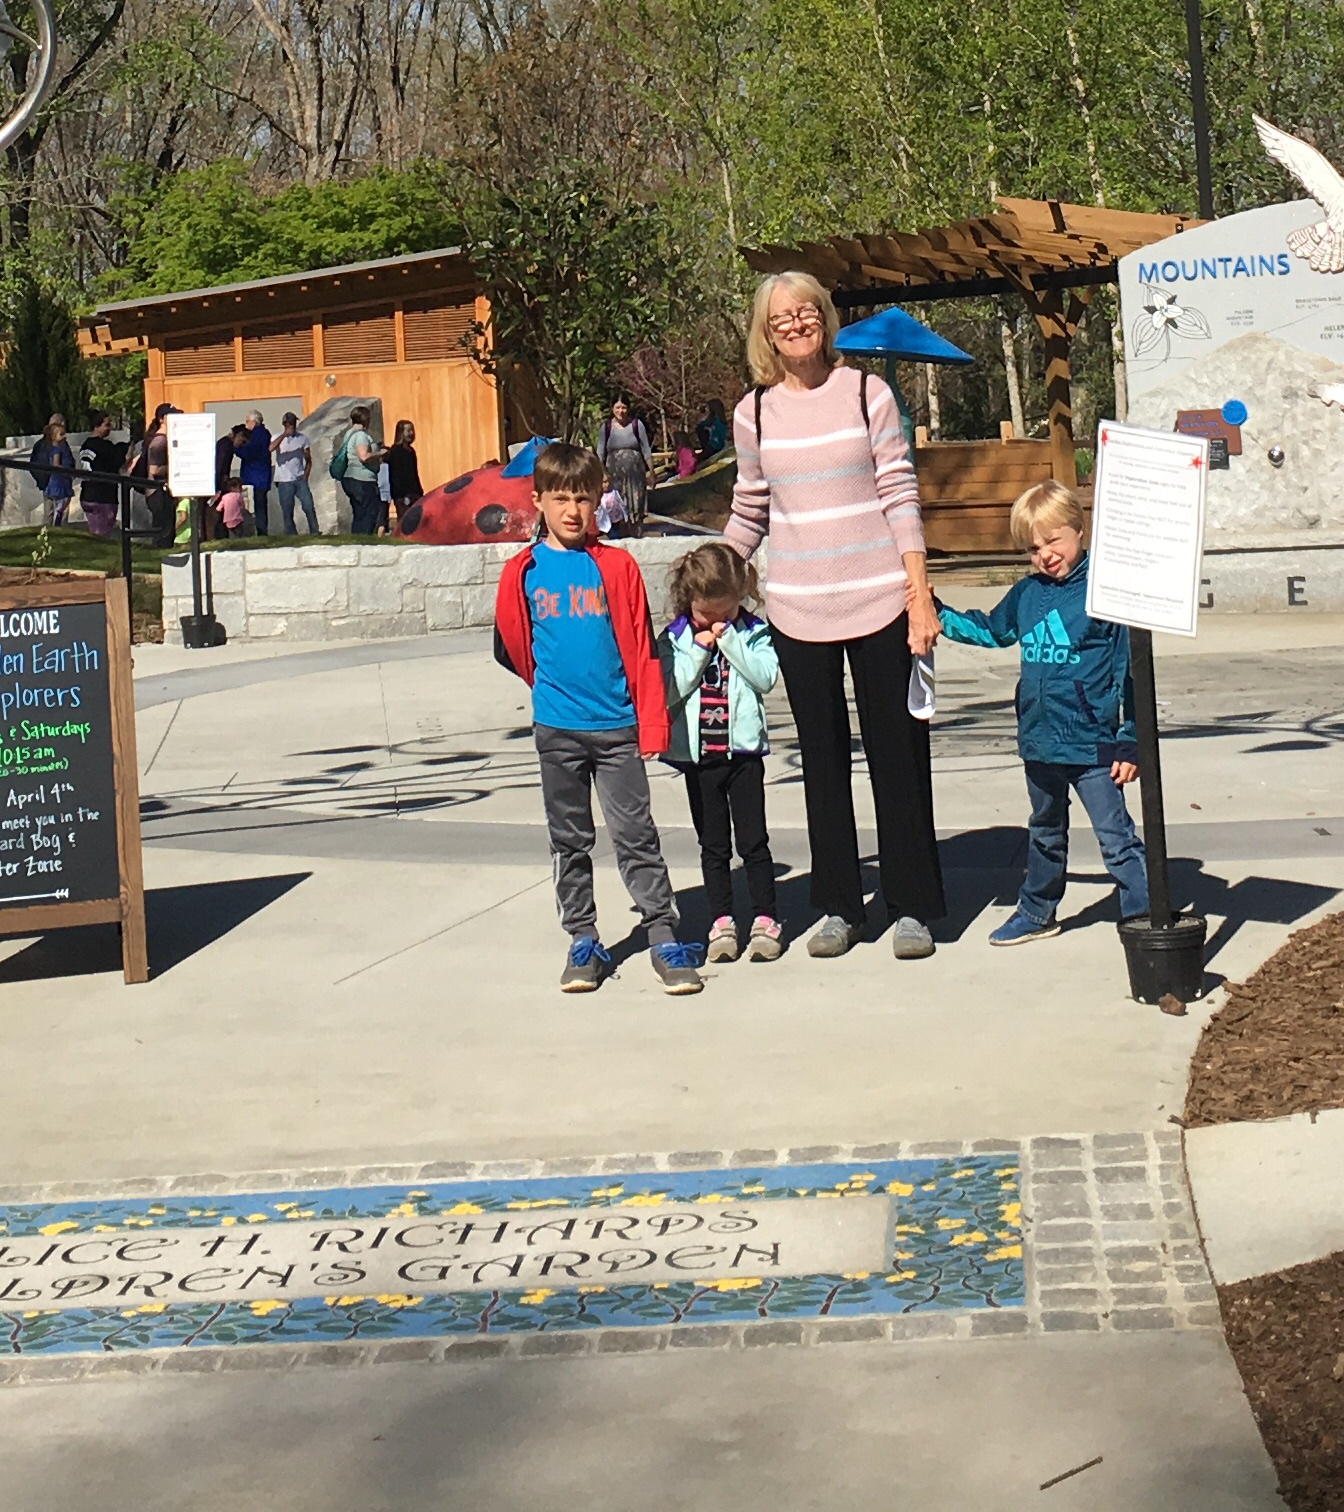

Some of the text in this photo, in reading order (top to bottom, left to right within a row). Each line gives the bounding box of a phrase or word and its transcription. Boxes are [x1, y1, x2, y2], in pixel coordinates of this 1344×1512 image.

[1138, 253, 1290, 284] MOUNTAINS
[534, 586, 561, 620] BE
[32, 641, 99, 674] Earth
[21, 719, 91, 744] Saturdays
[33, 747, 55, 759] am
[6, 784, 45, 809] April
[50, 783, 75, 804] 4th
[1, 815, 30, 830] meet
[35, 813, 55, 836] you
[60, 812, 73, 823] in
[30, 833, 61, 856] Bog
[23, 855, 63, 877] Zone
[199, 1231, 271, 1261] H.
[308, 1209, 759, 1252] RICHARDS
[396, 1241, 782, 1284] GARDEN
